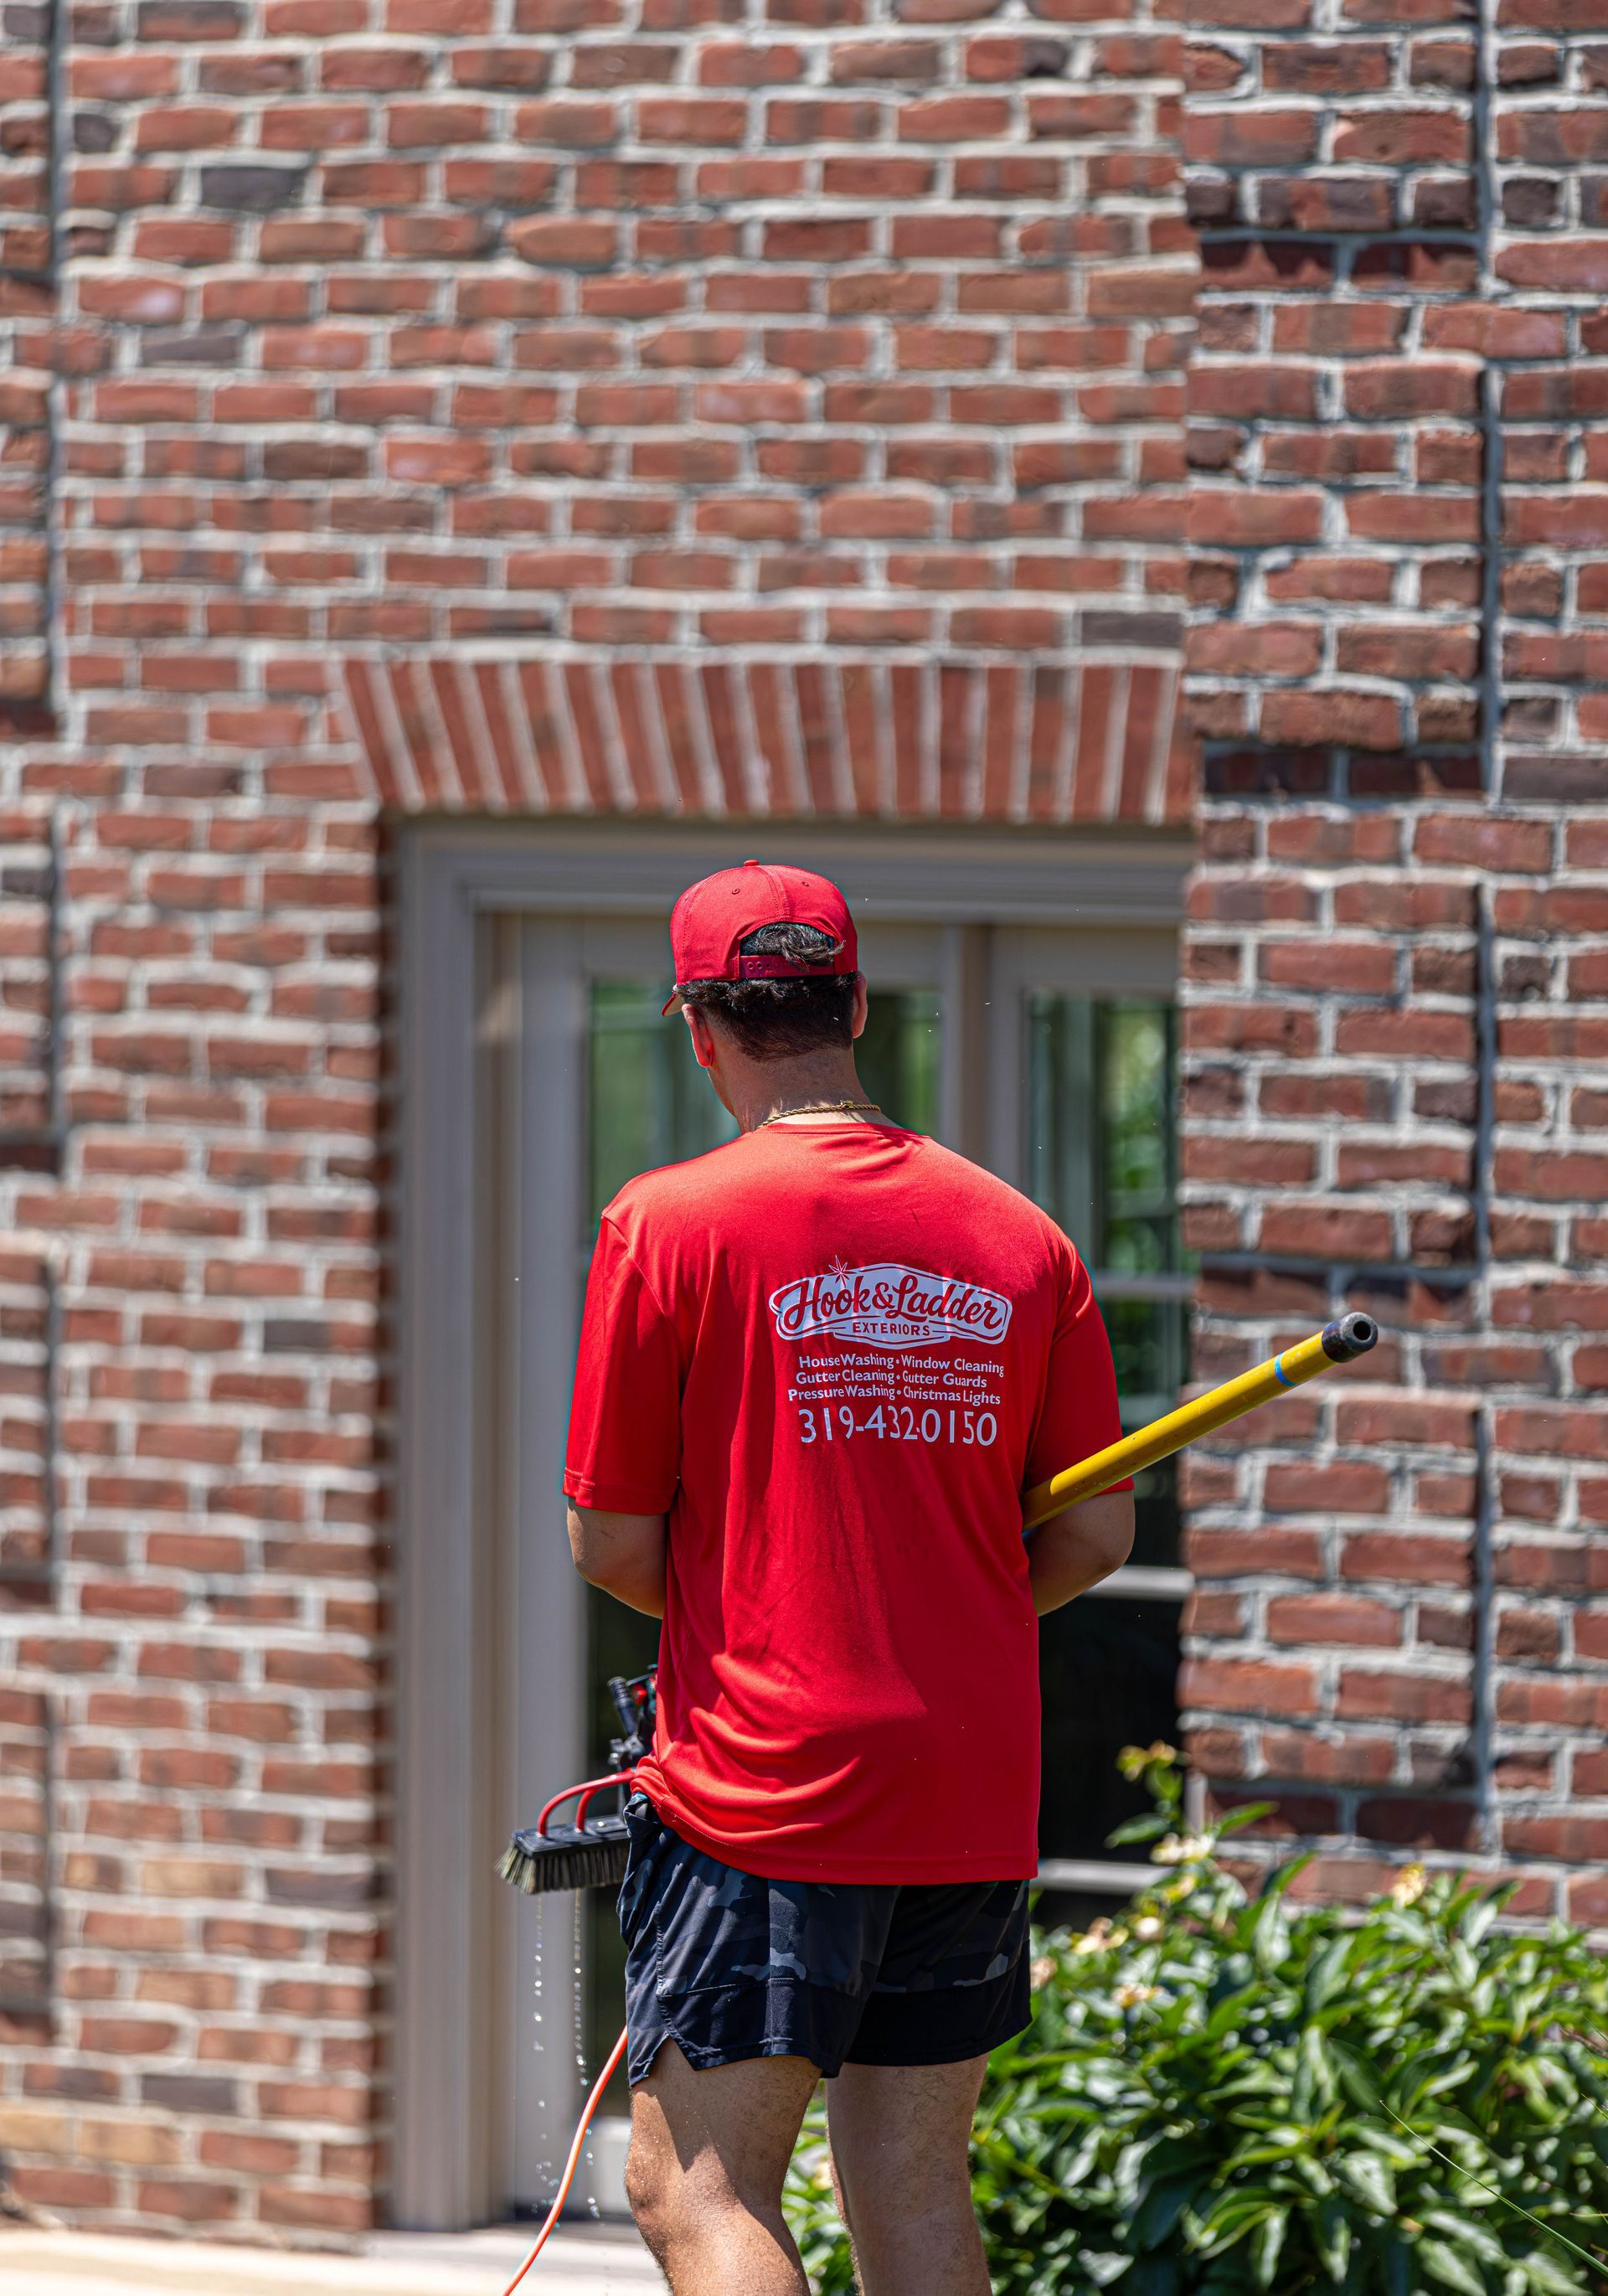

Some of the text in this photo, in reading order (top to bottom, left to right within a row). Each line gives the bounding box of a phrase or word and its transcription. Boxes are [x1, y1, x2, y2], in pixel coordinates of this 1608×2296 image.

[853, 1322, 930, 1335] EXTERIORS
[954, 1358, 1004, 1377] Cleaning
[796, 1370, 987, 1387] Gutter Cleaning Gutter Guards
[788, 1385, 1000, 1406] Pressure Washing Christmas Lights
